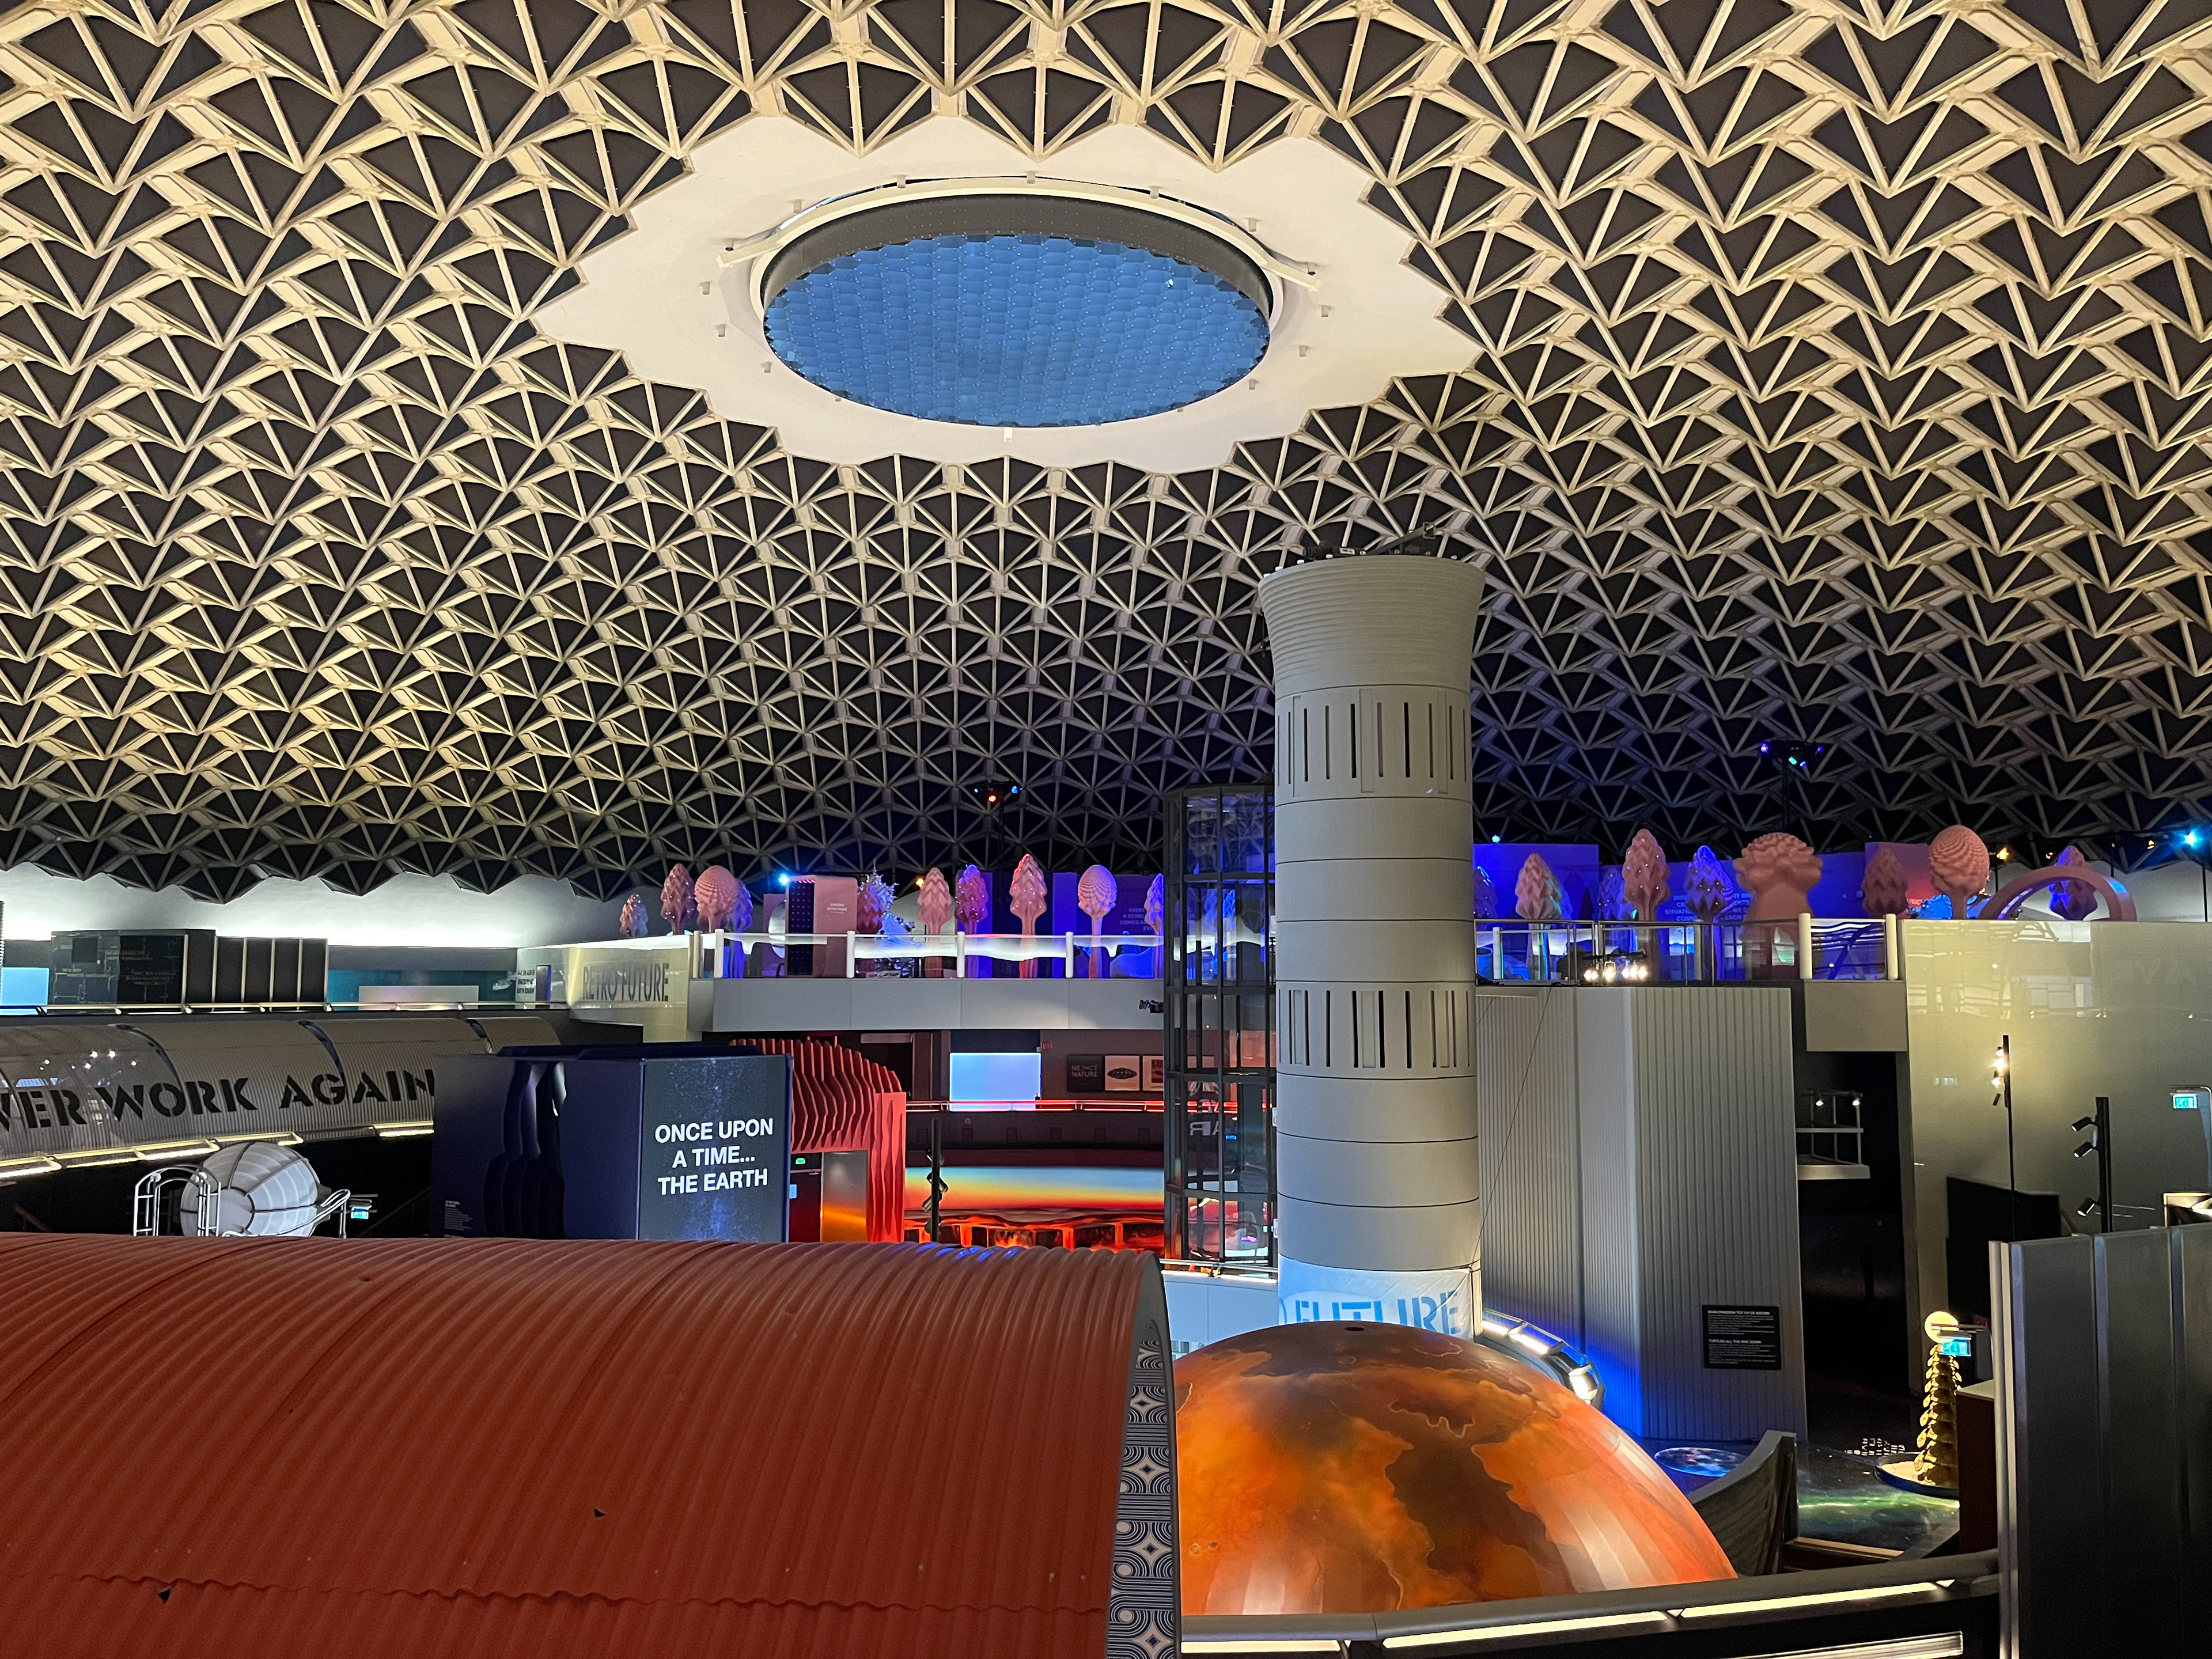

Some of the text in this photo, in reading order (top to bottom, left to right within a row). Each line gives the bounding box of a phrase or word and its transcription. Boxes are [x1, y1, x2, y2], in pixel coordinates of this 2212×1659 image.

[582, 963, 669, 1002] RETRO FUTURE
[94, 1077, 257, 1122] WORK
[279, 1069, 434, 1109] AGAIN
[654, 1118, 773, 1143] ONCE UPON
[672, 1145, 756, 1168] A TIME...
[657, 1168, 768, 1195] THE EARTH
